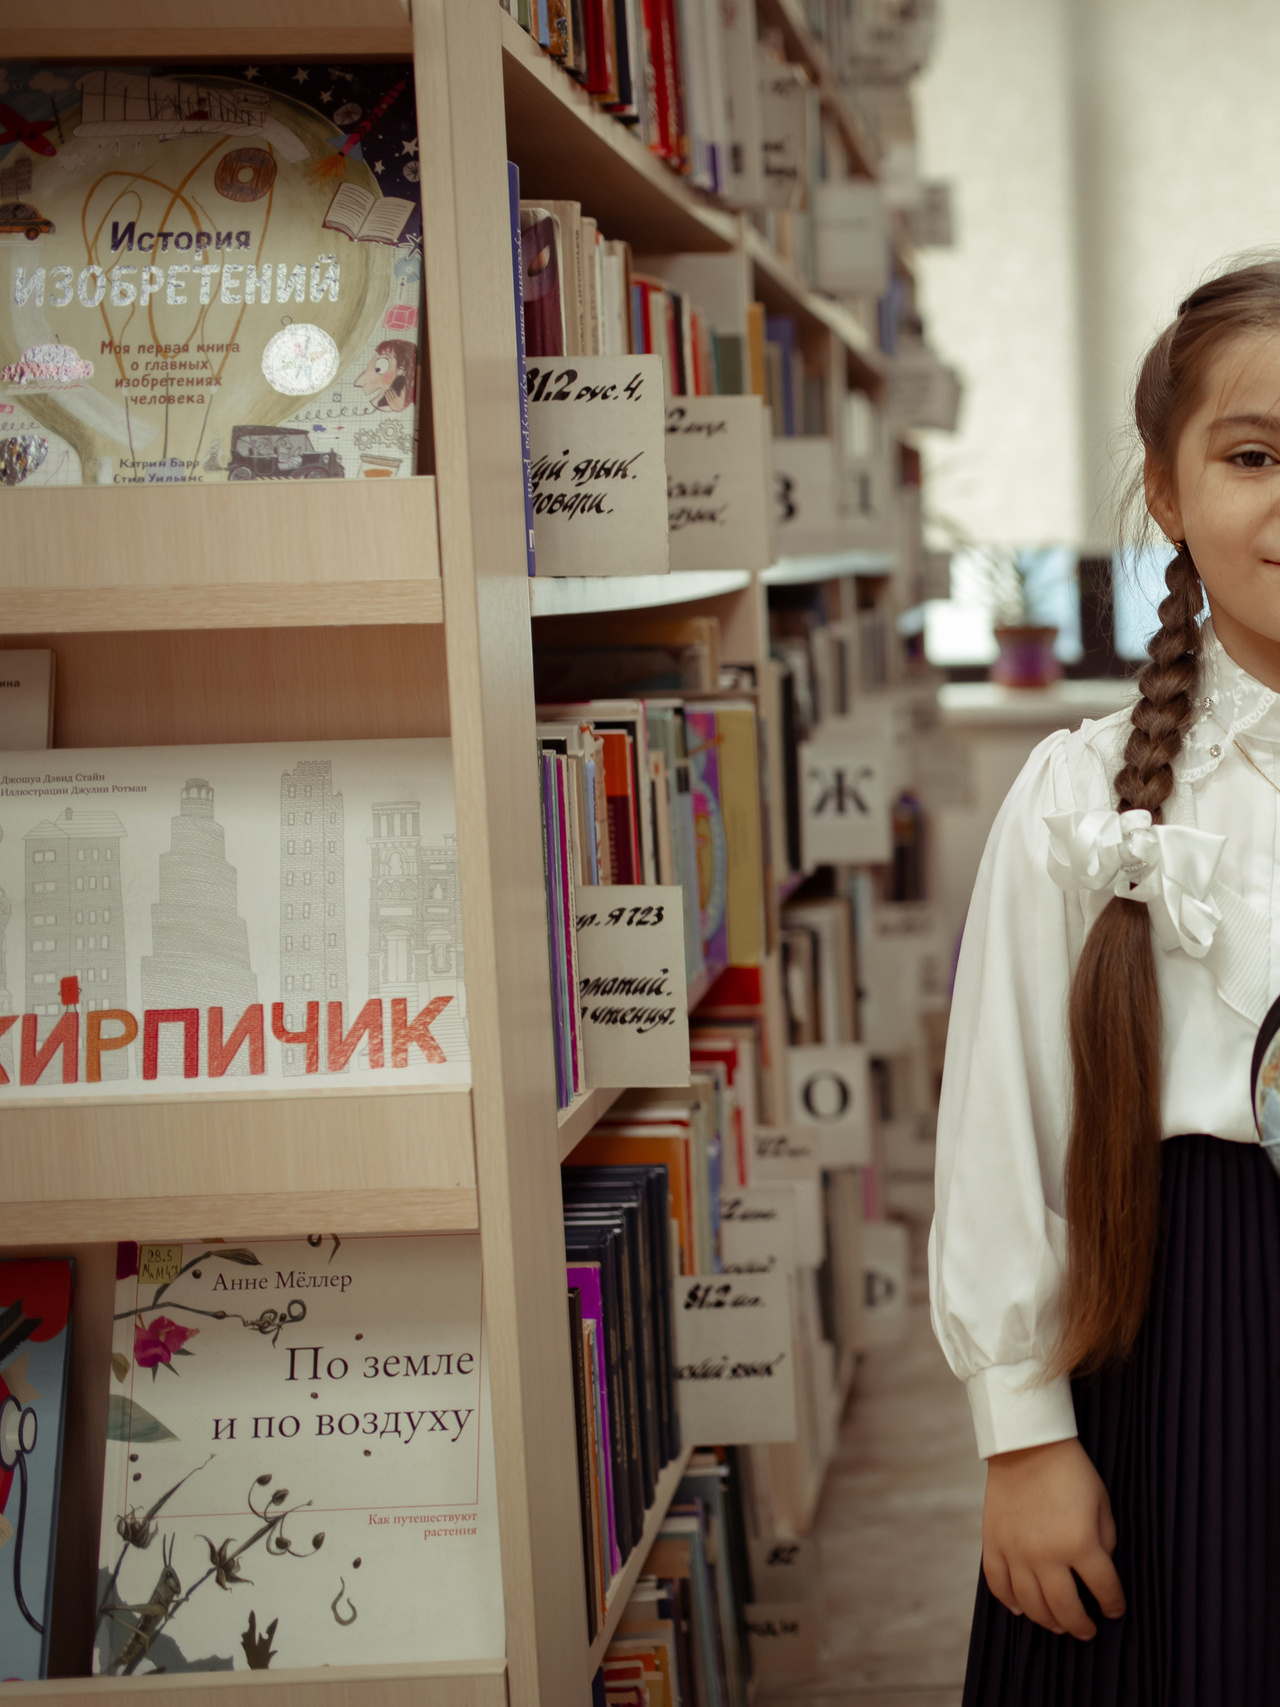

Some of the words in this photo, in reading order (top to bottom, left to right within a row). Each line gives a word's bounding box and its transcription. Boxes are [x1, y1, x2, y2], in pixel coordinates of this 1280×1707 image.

[110, 220, 252, 259] История
[13, 253, 341, 309] ИЗОБРЕТЕНИЙ
[100, 340, 131, 355] Моя
[137, 343, 190, 358] первая
[196, 342, 241, 354] книга
[130, 360, 139, 371] о
[144, 360, 209, 371] главных
[114, 373, 223, 391] изобретениях
[130, 393, 205, 405] человека
[119, 458, 167, 470] Кэтрин
[169, 457, 200, 470] Барр
[113, 473, 146, 484] Стив
[148, 473, 205, 484] Уильямс
[0, 775, 41, 786] Джошуа
[42, 773, 74, 784] Дэвид
[75, 772, 106, 783] Стайн
[0, 786, 69, 798] Иллюстрации
[70, 785, 110, 796] Джулии
[111, 784, 148, 794] Ротман
[808, 766, 874, 817] Ж
[802, 1069, 850, 1124] О
[212, 1272, 270, 1292] Анне
[274, 1270, 353, 1294] Мёллер
[284, 1346, 349, 1382] По
[362, 1350, 475, 1379] земле
[211, 1417, 240, 1442] и
[252, 1414, 302, 1440] по
[315, 1407, 475, 1444] воздуху
[367, 1512, 391, 1526] Как
[394, 1513, 478, 1529] путешествуют
[423, 1526, 478, 1541] растения
